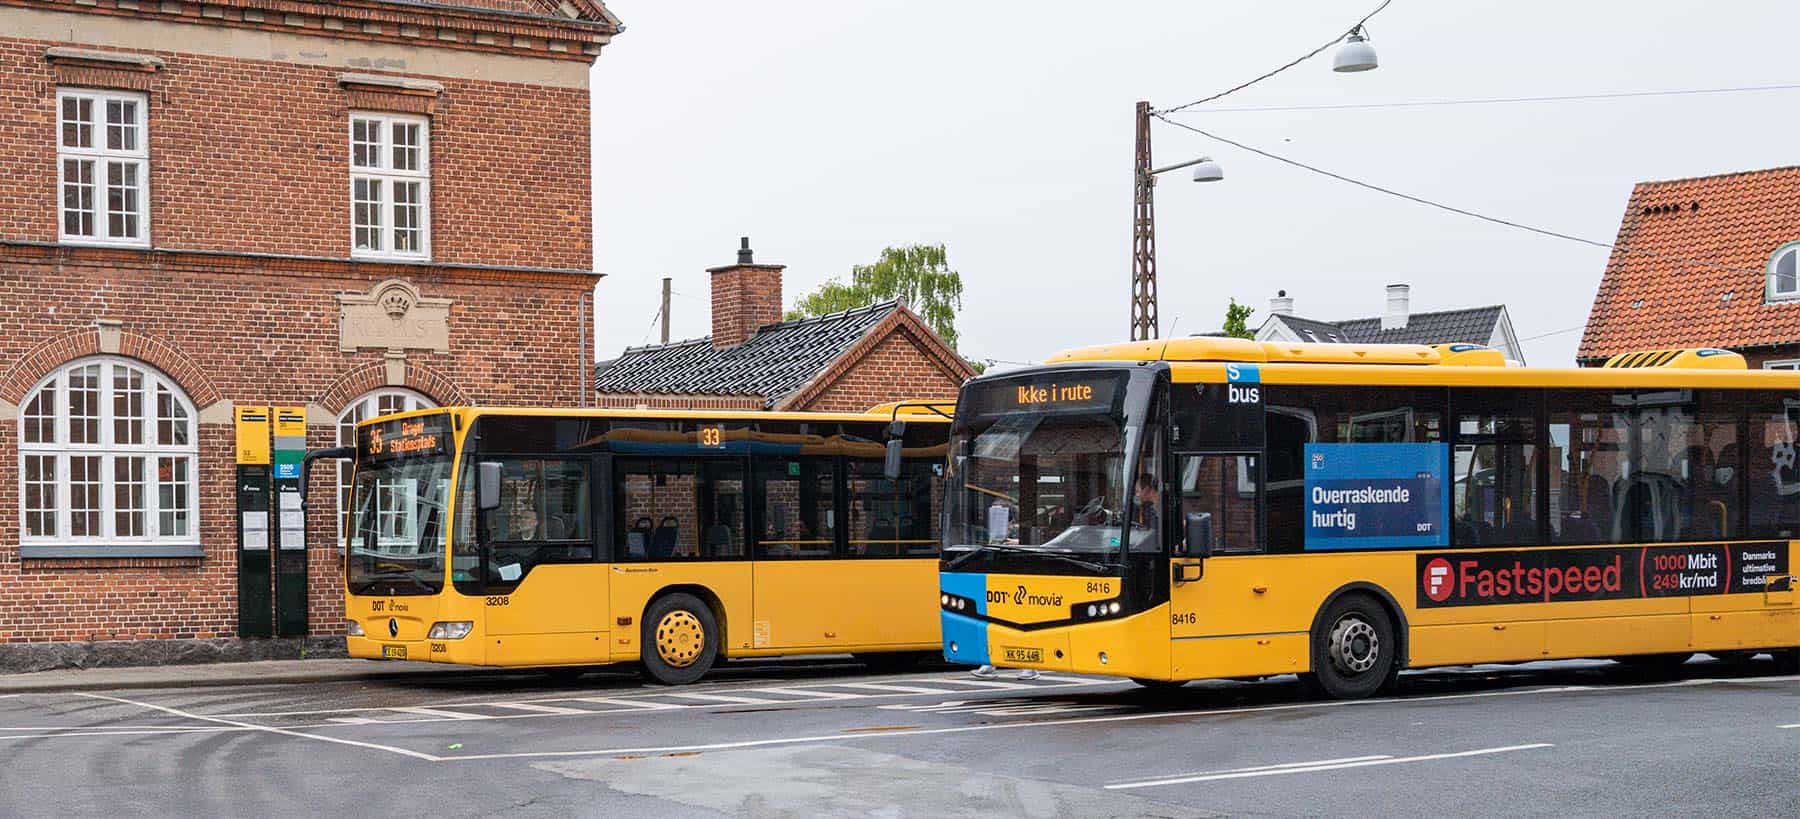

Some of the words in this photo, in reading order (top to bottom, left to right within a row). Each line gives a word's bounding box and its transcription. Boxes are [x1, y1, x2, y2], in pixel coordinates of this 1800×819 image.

[1228, 363, 1241, 380] S
[1018, 385, 1048, 404] Ikke
[1052, 383, 1057, 402] i
[1061, 384, 1093, 401] rute
[1228, 383, 1260, 403] bus
[370, 429, 383, 454] 35
[703, 428, 720, 445] 33
[1312, 486, 1410, 504] Overraskende
[1312, 508, 1355, 530] hurtig
[1416, 523, 1432, 531] DOT
[1654, 554, 1687, 571] 1000
[1688, 553, 1718, 570] Mbit
[1742, 551, 1776, 561] Danmarks
[1742, 564, 1776, 573] ultimative
[1460, 554, 1622, 602] Fastspeed
[1653, 574, 1679, 590] 249
[1680, 571, 1717, 588] kr/md
[1086, 582, 1111, 594] 8416
[486, 596, 510, 607] 3208
[987, 591, 1009, 603] DOT
[1029, 592, 1063, 606] movia
[1172, 612, 1196, 625] 8416
